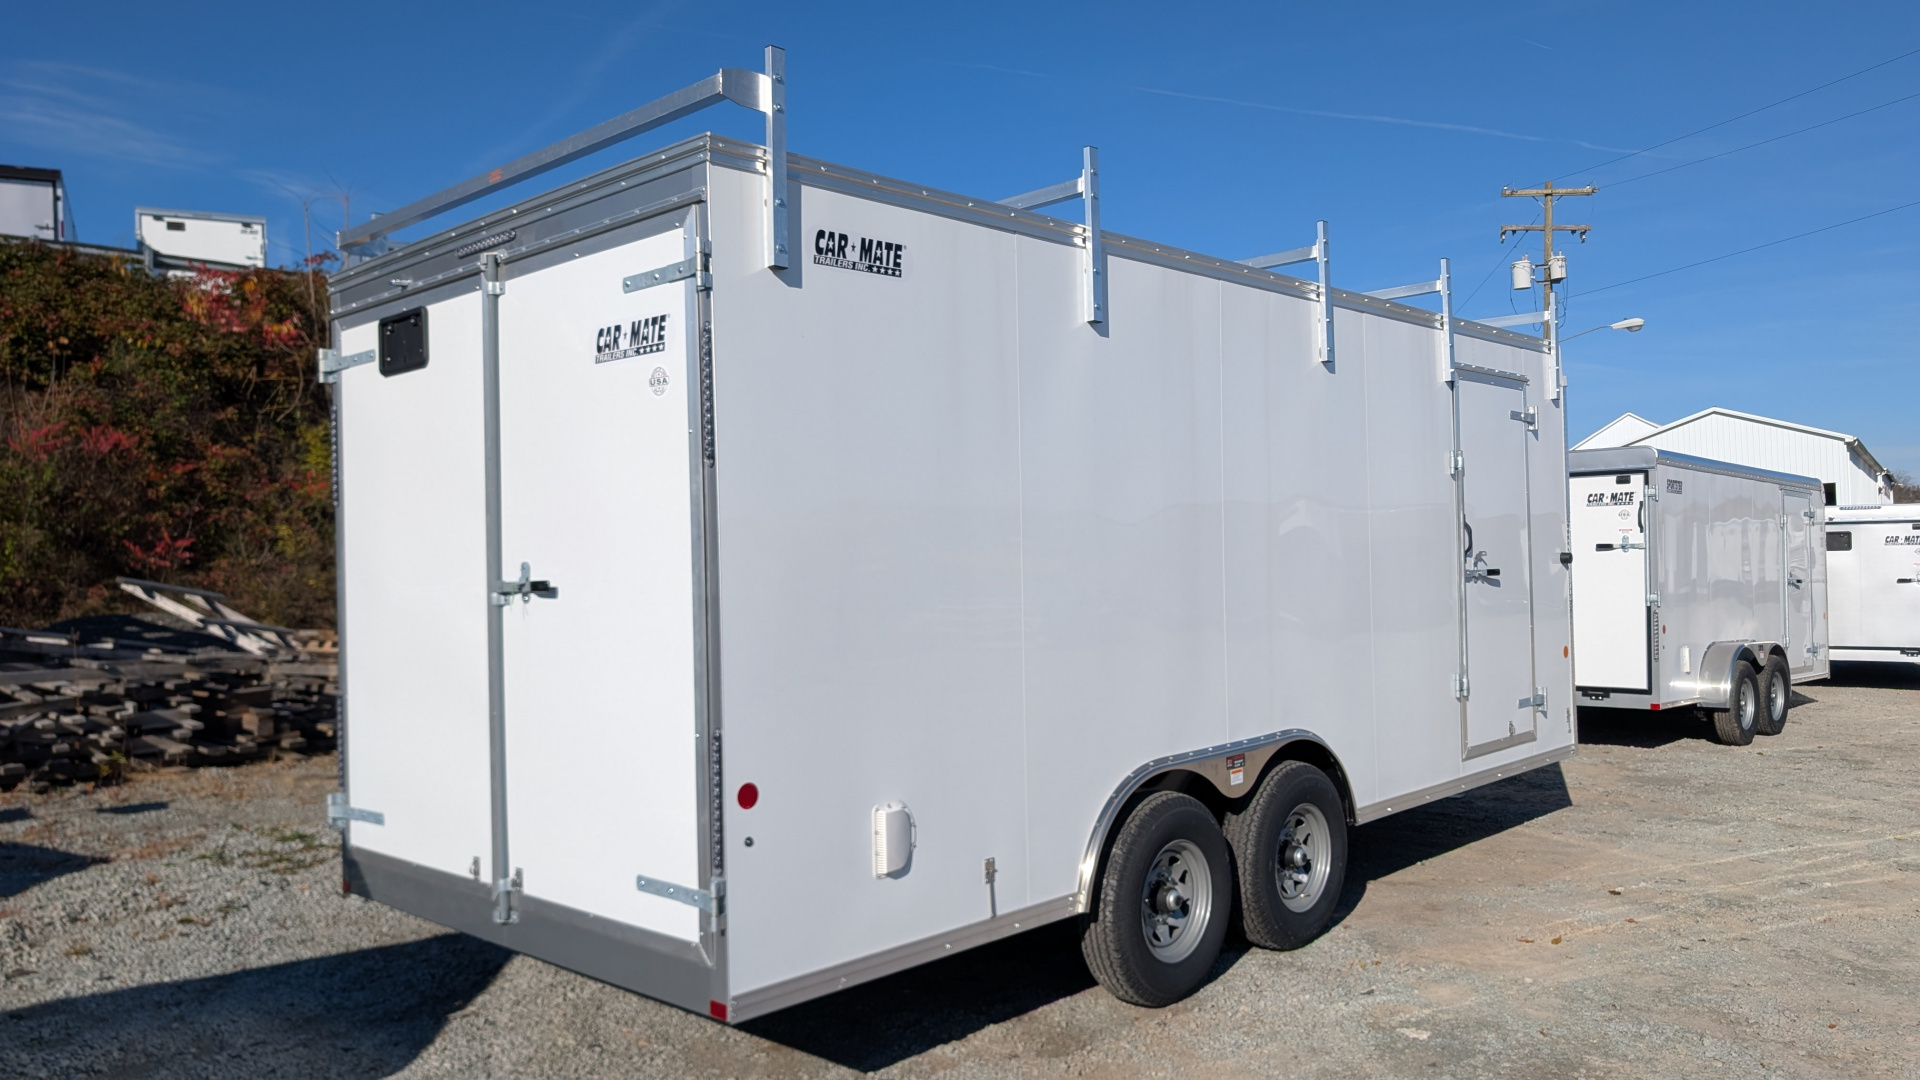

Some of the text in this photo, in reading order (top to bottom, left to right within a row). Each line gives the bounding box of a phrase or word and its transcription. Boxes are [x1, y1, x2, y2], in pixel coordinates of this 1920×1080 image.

[815, 229, 903, 268] CAR MATE
[814, 255, 871, 272] TRAILERS INC.
[597, 314, 667, 354] CAR MATE
[596, 350, 625, 362] TRAILERS
[650, 377, 668, 386] USA
[1587, 492, 1634, 503] CAR MATE
[1885, 535, 1900, 543] CAR
